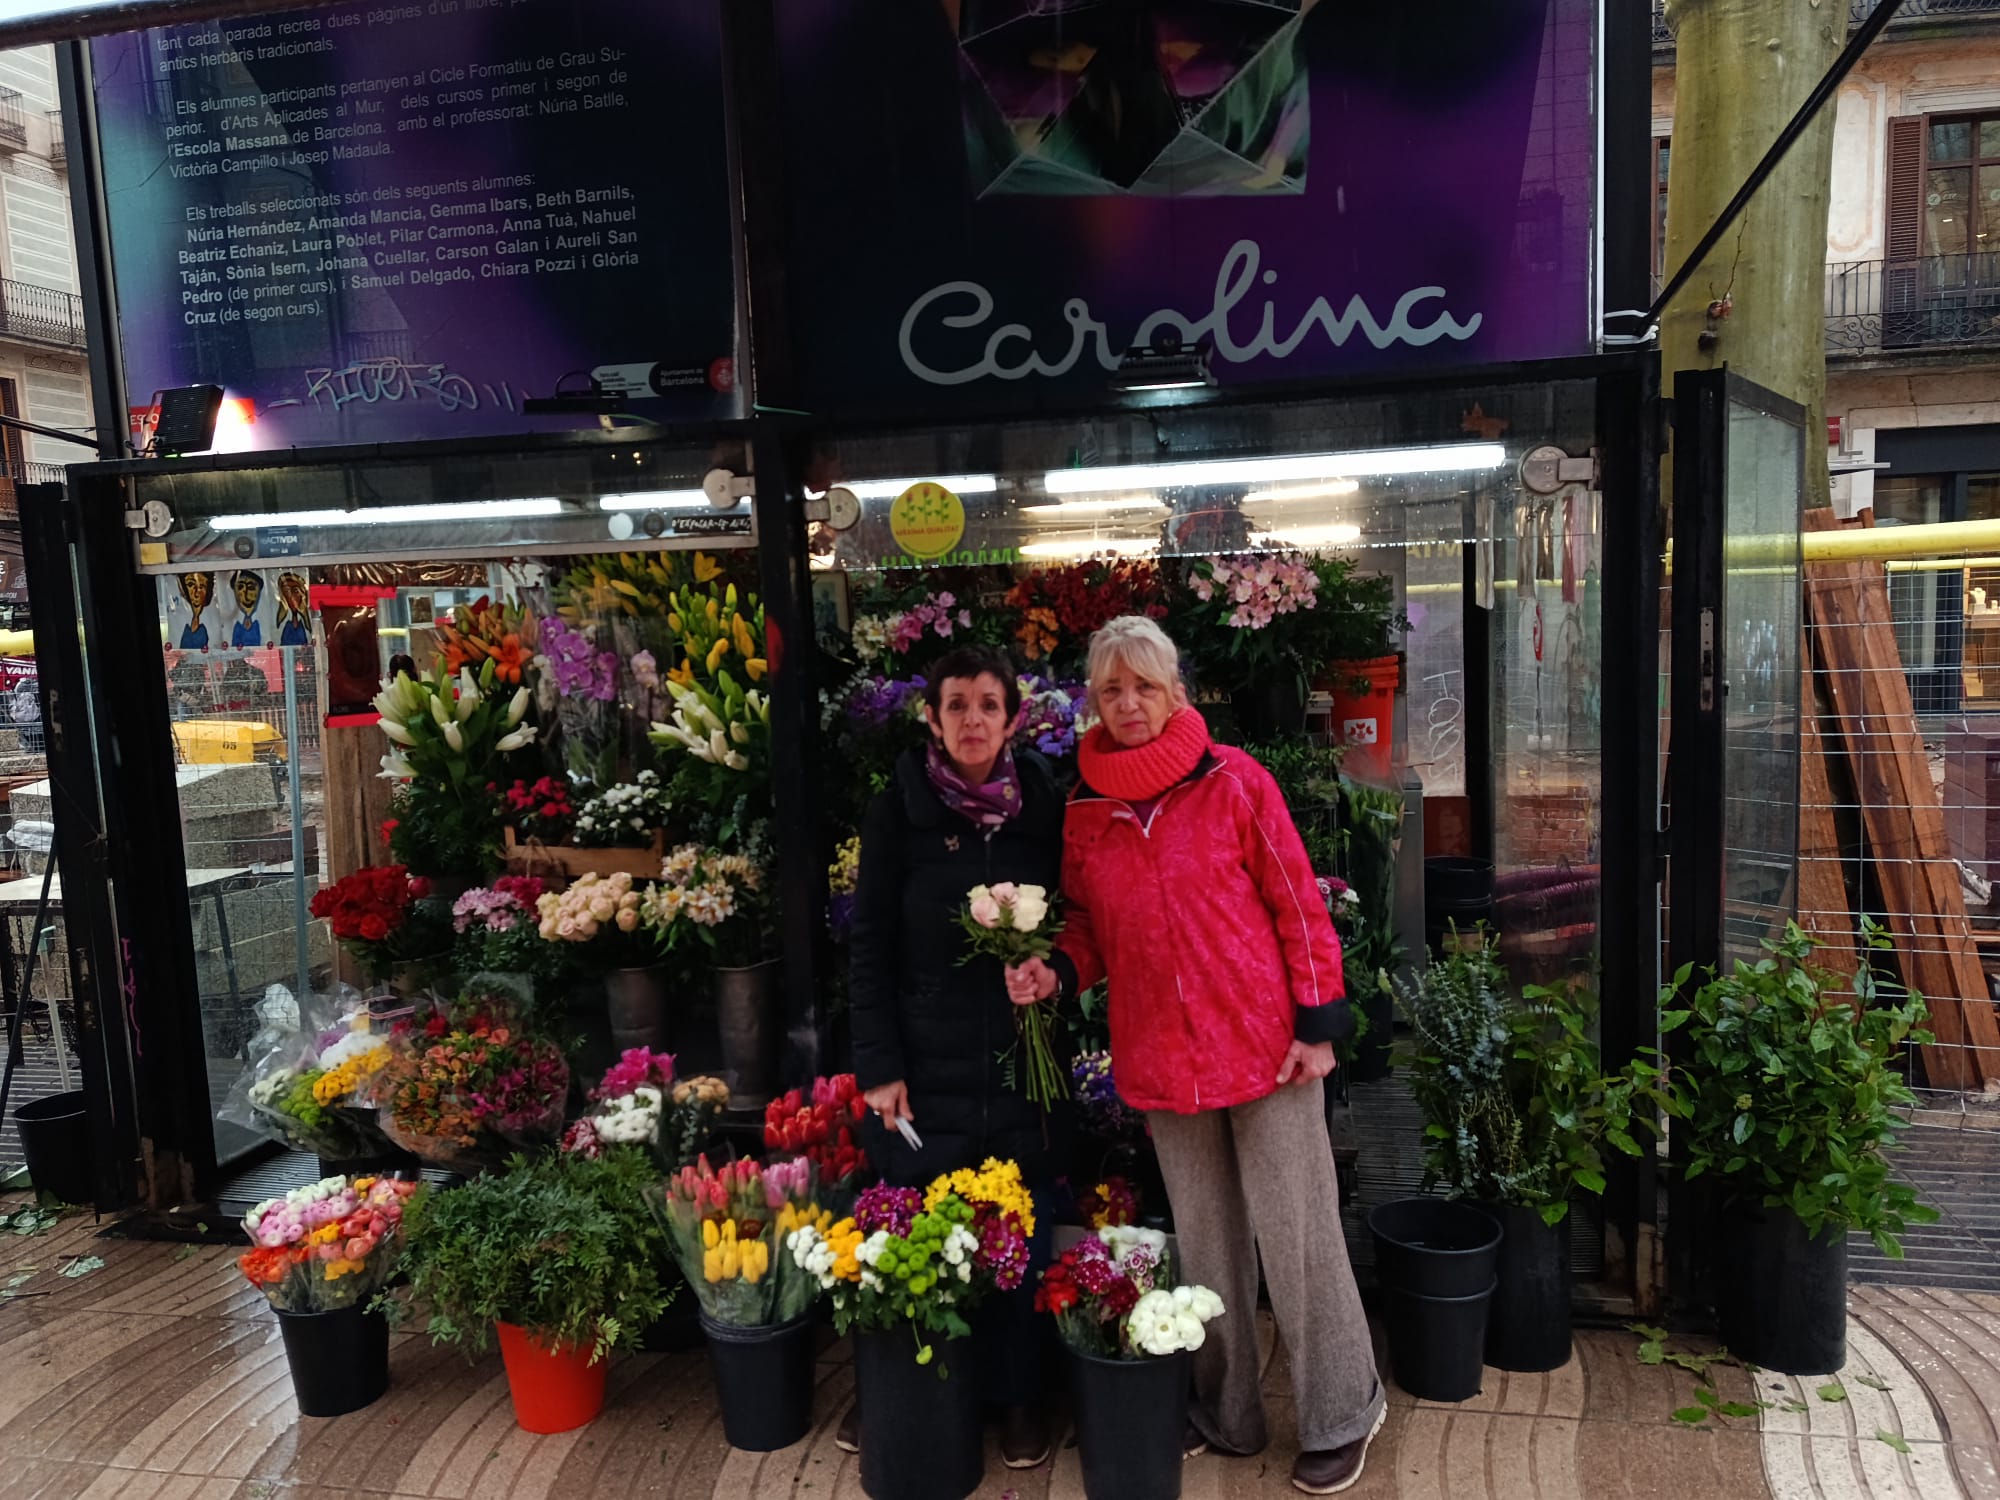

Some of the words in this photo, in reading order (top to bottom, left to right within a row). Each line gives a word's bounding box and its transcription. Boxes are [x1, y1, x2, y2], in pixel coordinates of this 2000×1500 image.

[157, 36, 182, 51] tant
[188, 30, 219, 47] cada
[226, 24, 272, 44] parada
[278, 18, 321, 35] recrea
[327, 12, 361, 29] dues
[367, 4, 422, 25] pàgines
[428, 0, 458, 15] d'un
[159, 56, 197, 73] antics
[201, 48, 254, 67] herbaris
[258, 36, 337, 58] tradicionals.
[177, 100, 196, 115] Els
[201, 94, 257, 112] alumnes
[261, 83, 336, 107] participants
[340, 75, 408, 96] pertanyen
[413, 71, 425, 86] al
[430, 67, 465, 84] Cicle
[469, 60, 532, 79] Formatiu
[536, 55, 555, 71] de
[559, 51, 596, 67] Grau
[601, 47, 627, 62] Su-
[166, 121, 206, 140] perior.
[221, 113, 258, 131] d'Arts
[264, 103, 328, 127] Aplicades
[336, 103, 348, 117] al
[355, 99, 385, 115] Mur,
[401, 93, 430, 109] dels
[437, 87, 484, 104] cursos
[491, 81, 536, 99] primer
[556, 73, 600, 92] segon
[609, 70, 628, 84] de
[168, 140, 221, 158] l'Escola
[226, 133, 288, 152] Massana
[292, 129, 310, 143] de
[314, 121, 386, 141] Barcelona.
[397, 115, 428, 131] amb
[433, 112, 445, 126] el
[450, 104, 533, 128] professorat:
[539, 97, 578, 114] Núria
[583, 92, 629, 110] Batlle,
[170, 160, 218, 179] Victòria
[221, 151, 279, 173] Campillo
[289, 147, 329, 166] Josep
[333, 141, 394, 161] Madaula.
[186, 206, 206, 221] Els
[210, 201, 256, 218] treballs
[260, 192, 341, 213] seleccionats
[345, 190, 367, 205] són
[373, 186, 401, 201] dels
[405, 179, 468, 199] seguents
[472, 173, 536, 191] alumnes:
[187, 227, 224, 243] Núria
[227, 220, 305, 239] Hernández,
[308, 212, 367, 230] Amanda
[370, 206, 427, 223] Mancía,
[430, 202, 487, 218] Gemma
[490, 197, 532, 213] Ibars,
[536, 191, 571, 207] Beth
[575, 185, 635, 203] Barnils,
[178, 247, 227, 264] Beatriz
[230, 240, 289, 259] Echaniz,
[292, 237, 332, 253] Laura
[336, 230, 386, 249] Poblet,
[390, 227, 422, 243] Pilar
[428, 222, 498, 240] Carmona,
[502, 217, 541, 233] Anna
[545, 211, 578, 229] Tuà,
[583, 206, 636, 224] Nahuel
[180, 269, 221, 287] Taján,
[226, 264, 265, 280] Sònia
[271, 260, 311, 276] Isern,
[316, 254, 368, 272] Johana
[374, 249, 429, 267] Cuellar,
[435, 245, 488, 261] Carson
[495, 239, 539, 256] Galan
[555, 232, 600, 249] Aureli
[608, 229, 638, 245] San
[182, 290, 223, 305] Pedro
[227, 286, 249, 303] (de
[253, 283, 295, 299] primer
[299, 278, 337, 295] curs),
[351, 271, 404, 289] Samuel
[410, 266, 475, 285] Delgado,
[480, 261, 530, 277] Chiara
[535, 256, 576, 272] Pozzi
[592, 251, 639, 268] Glòria
[184, 310, 216, 325] Cruz
[219, 307, 241, 325] (de
[244, 304, 283, 322] segon
[287, 300, 324, 318] curs).
[899, 239, 1482, 385] Carolina
[660, 375, 704, 386] Barcelona
